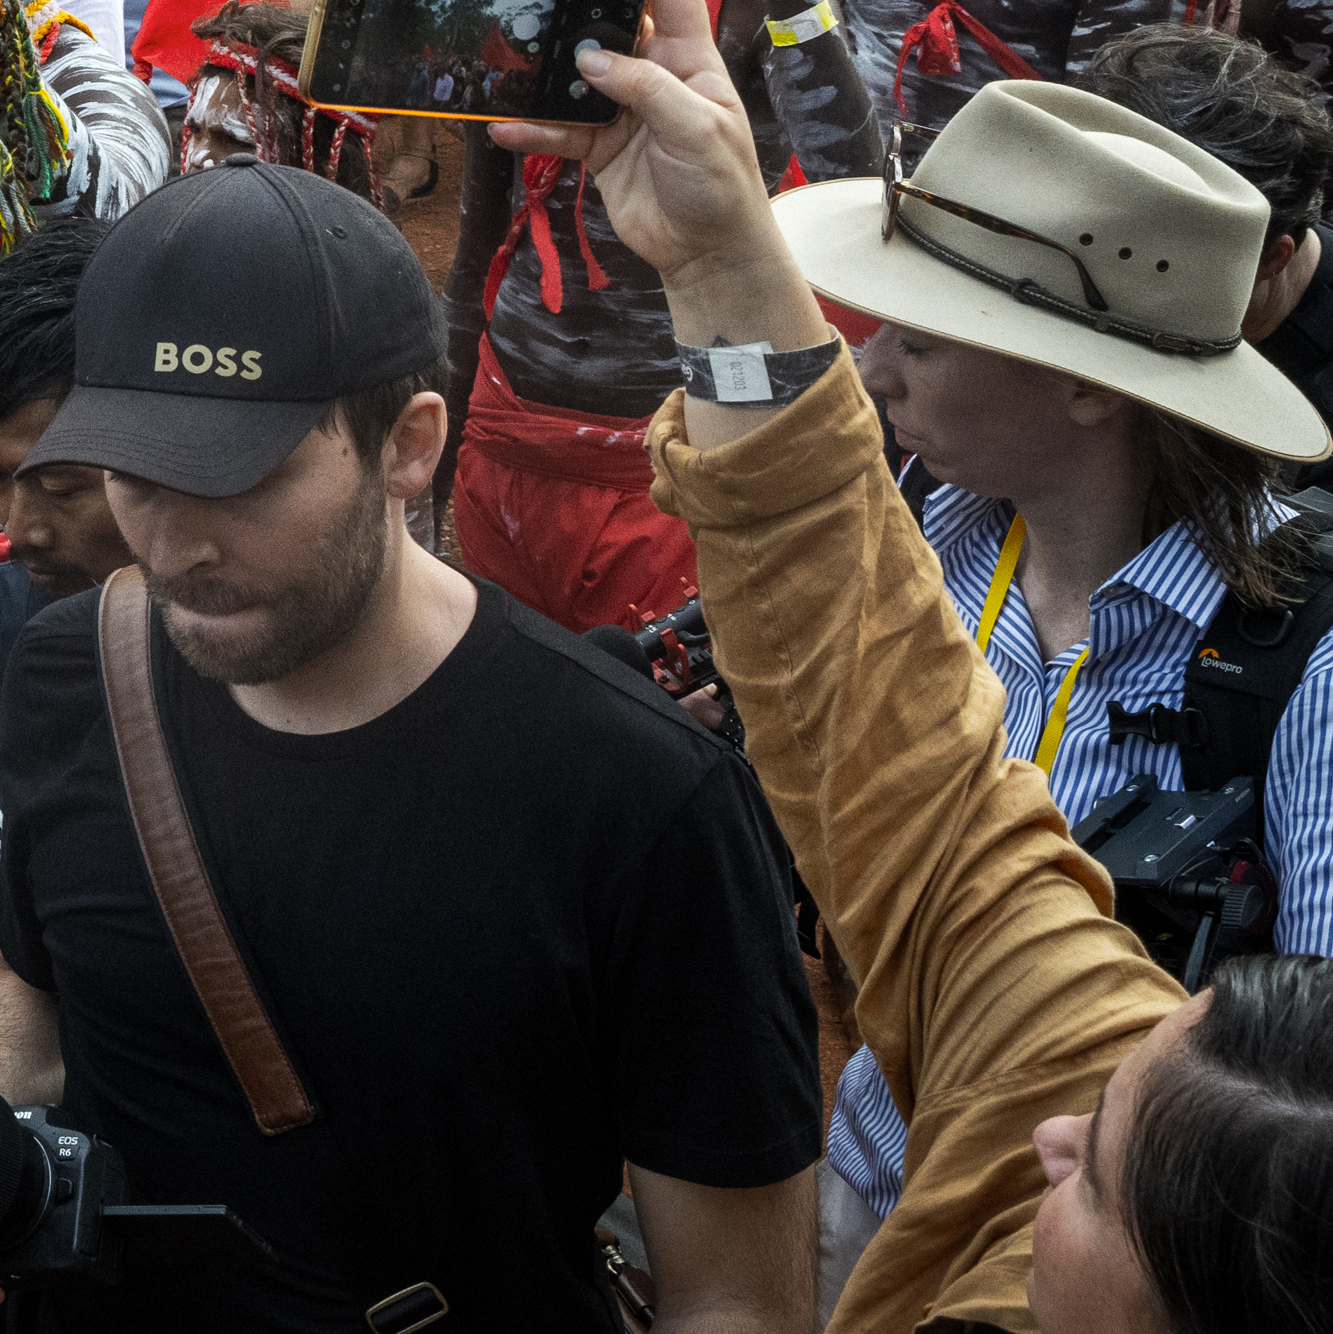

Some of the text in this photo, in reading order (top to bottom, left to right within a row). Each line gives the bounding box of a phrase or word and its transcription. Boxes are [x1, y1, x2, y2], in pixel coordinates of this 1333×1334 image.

[154, 342, 263, 381] BOSS
[1201, 656, 1243, 674] Lowepro
[58, 1136, 79, 1146] EOS
[59, 1148, 72, 1157] R6
